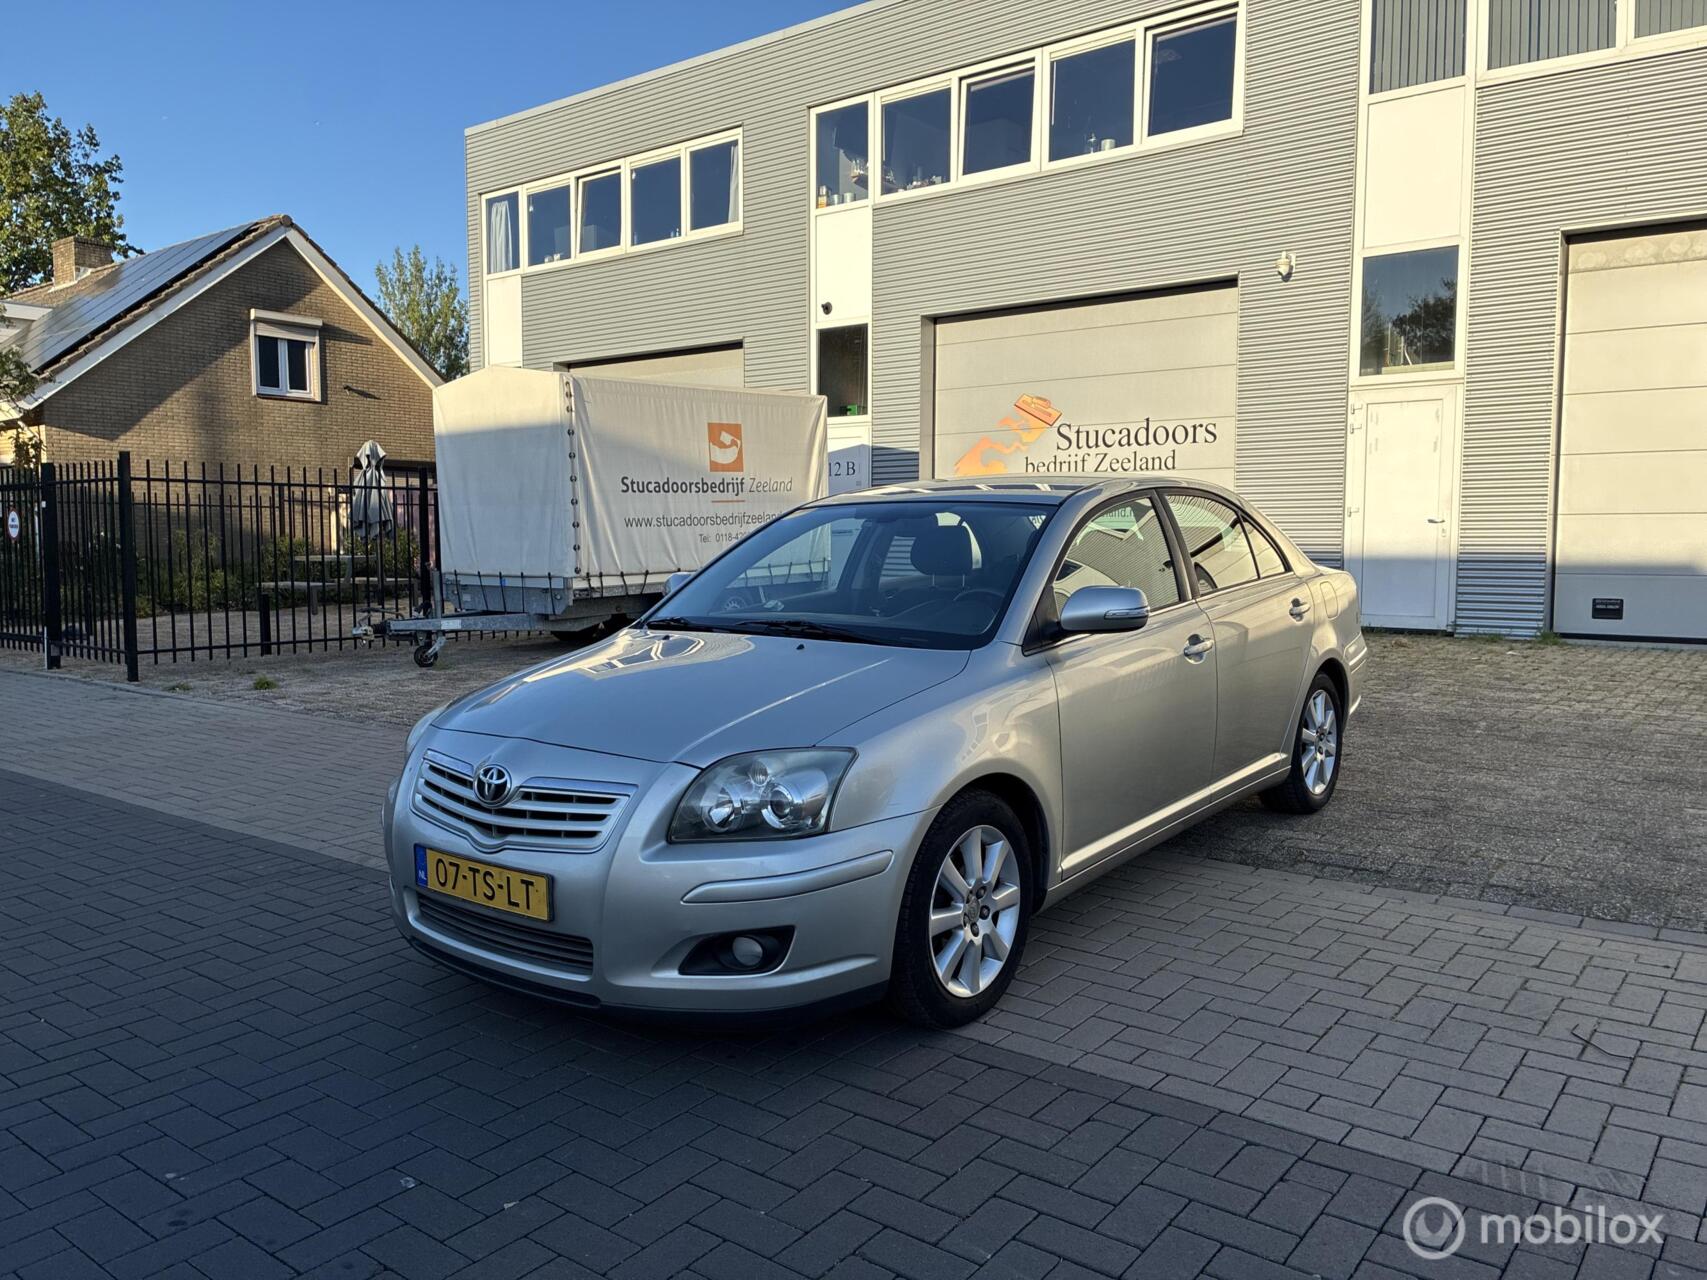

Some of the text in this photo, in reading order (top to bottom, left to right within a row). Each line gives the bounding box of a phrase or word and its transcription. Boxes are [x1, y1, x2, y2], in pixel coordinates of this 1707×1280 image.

[1056, 417, 1217, 451] Stucadoors
[846, 461, 856, 476] B
[1093, 449, 1176, 473] Zeeland
[620, 476, 793, 497] Stucadoorsbedrijf Zeeland
[418, 869, 427, 881] NL
[435, 857, 535, 911] 07-TS-LT
